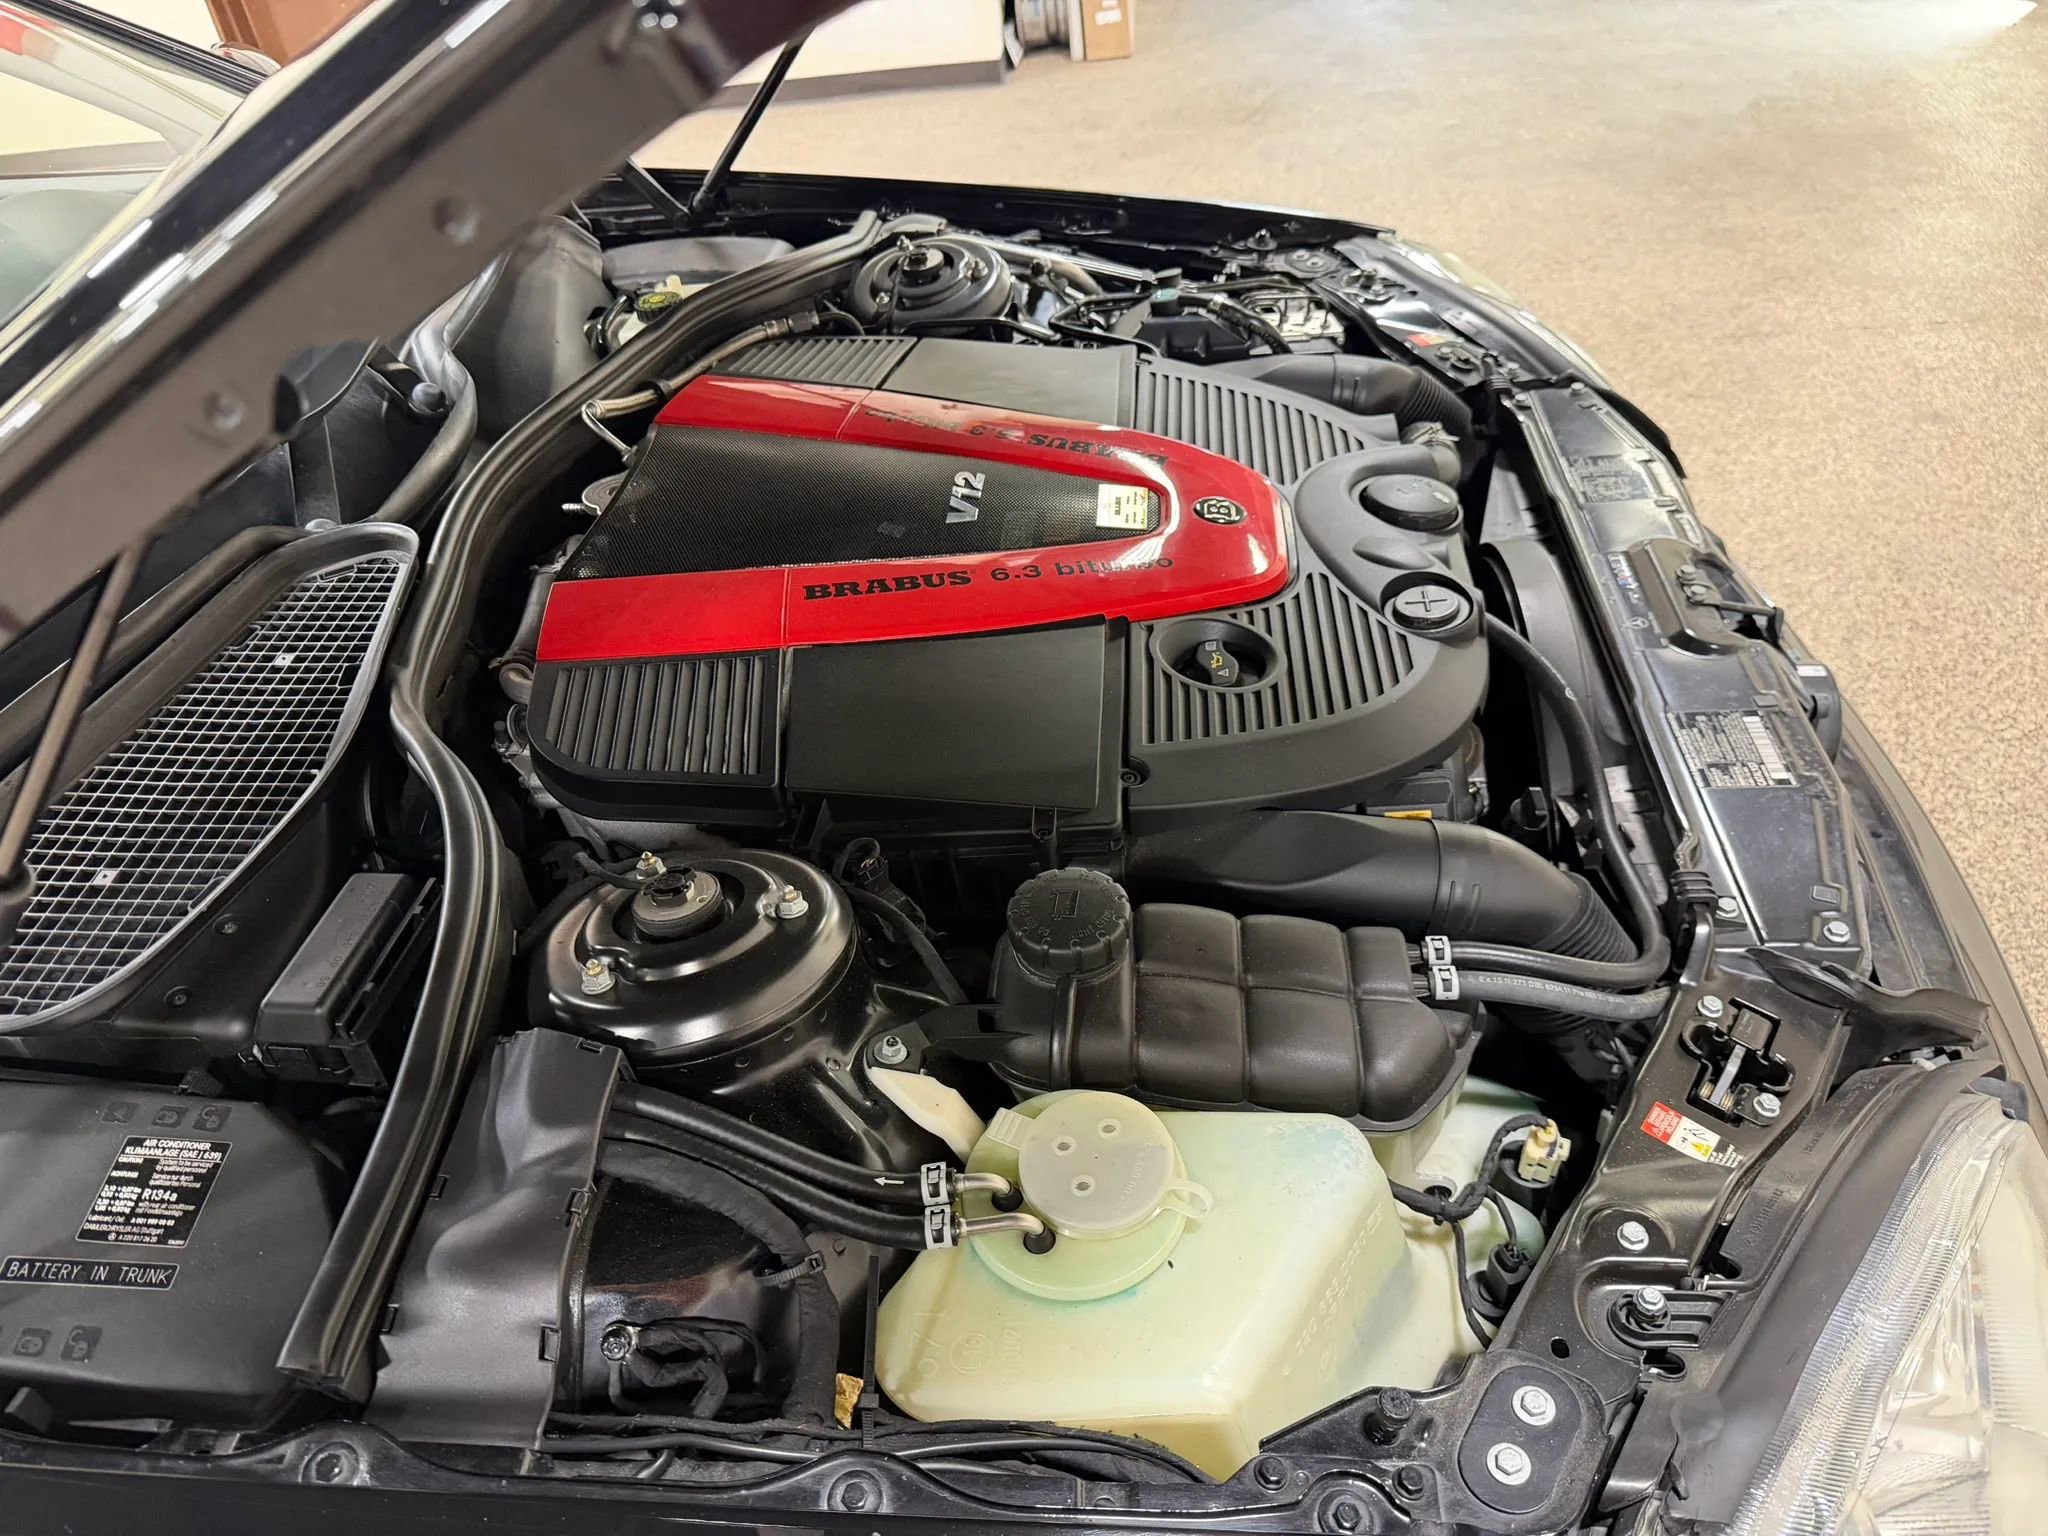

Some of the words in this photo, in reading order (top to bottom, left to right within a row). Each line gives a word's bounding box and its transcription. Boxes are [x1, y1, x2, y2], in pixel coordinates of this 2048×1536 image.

[945, 471, 986, 524] V12
[803, 570, 971, 600] BRABUS
[990, 565, 1042, 582] 6.3
[125, 1145, 179, 1157] KLIMAANLAGE
[179, 1149, 198, 1159] (SAE
[158, 1139, 211, 1150] CONDITIONER
[141, 1188, 179, 1201] R134a
[7, 1260, 82, 1281] BATTERY
[90, 1265, 109, 1281] IN
[118, 1266, 174, 1284] TRUNK
